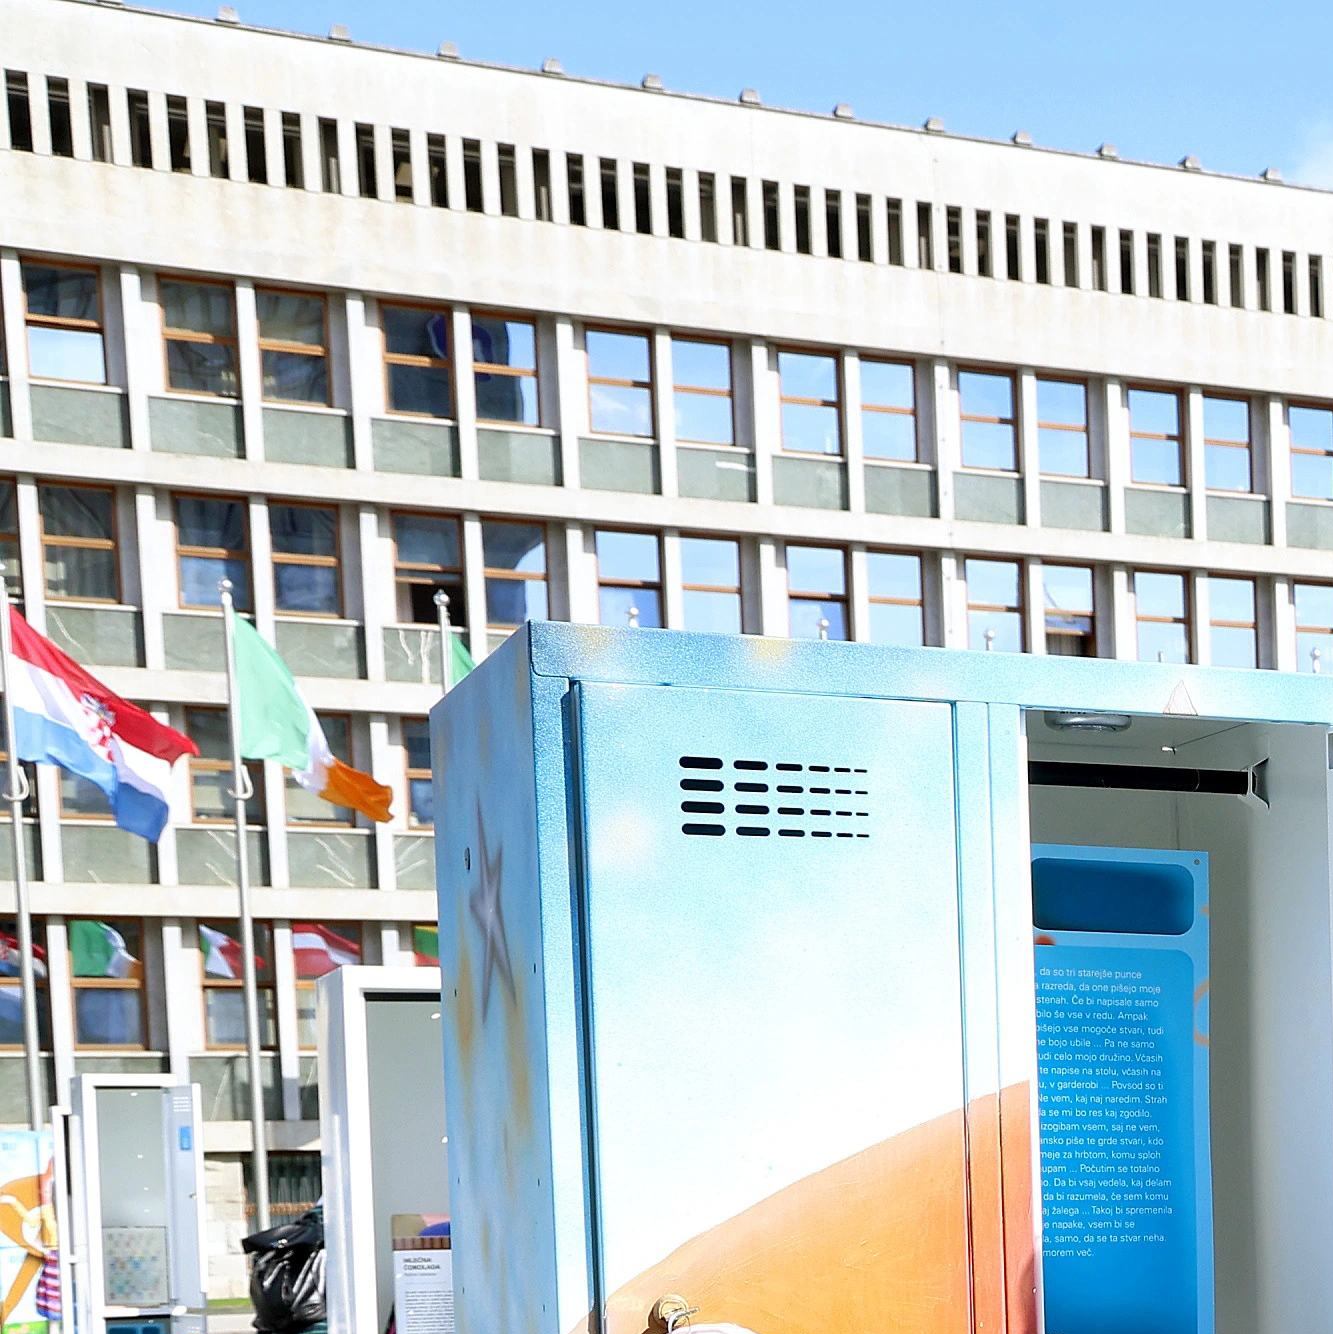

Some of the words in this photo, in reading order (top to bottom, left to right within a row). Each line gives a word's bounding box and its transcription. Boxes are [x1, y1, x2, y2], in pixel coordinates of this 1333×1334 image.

[1040, 967, 1050, 976] da
[1053, 969, 1064, 977] so
[1066, 969, 1075, 977] tri
[1078, 969, 1112, 980] starejše
[1115, 971, 1142, 980] punce
[1041, 982, 1076, 992] razreda,
[1079, 983, 1090, 991] da
[1111, 984, 1136, 994] pišejo
[1139, 985, 1160, 994] moje
[1036, 996, 1068, 1004] stenah.
[1072, 994, 1084, 1004] Če
[1086, 996, 1094, 1004] bi
[1096, 997, 1132, 1007] napisale
[1054, 1010, 1064, 1018] še
[1118, 1012, 1148, 1022] Ampak
[1081, 1025, 1117, 1035] mogoče
[1119, 1026, 1145, 1035] stvari,
[1048, 1038, 1068, 1048] bojo
[1070, 1039, 1091, 1047] ubile
[1104, 1039, 1115, 1047] Pa
[1054, 1052, 1072, 1061] celo
[1075, 1053, 1097, 1062] mojo
[1099, 1053, 1133, 1062] družino.
[1135, 1053, 1163, 1062] Včasih
[1095, 1067, 1118, 1076] stolu,
[1122, 1068, 1148, 1076] včasih
[1057, 1081, 1098, 1090] garderobi
[1111, 1081, 1142, 1089] Povsod
[1158, 1082, 1163, 1090] ti
[1075, 1094, 1087, 1104] kaj
[1090, 1095, 1102, 1105] naj
[1105, 1095, 1142, 1103] naredim.
[1144, 1095, 1167, 1104] Strah
[1075, 1108, 1087, 1116] bo
[1105, 1109, 1117, 1119] kaj
[1120, 1109, 1152, 1119] zgodilo.
[1040, 1122, 1079, 1132] izogibam
[1082, 1124, 1109, 1132] vsem,
[1111, 1123, 1124, 1132] saj
[1139, 1124, 1160, 1132] vem,
[1065, 1136, 1084, 1146] piše
[1098, 1136, 1118, 1146] grde
[1120, 1137, 1145, 1146] stvari,
[1148, 1137, 1164, 1145] kdo
[1075, 1151, 1109, 1160] hrbtom,
[1111, 1150, 1135, 1159] komu
[1138, 1151, 1160, 1160] sploh
[1080, 1164, 1115, 1173] Počutim
[1130, 1165, 1160, 1173] totalno
[1054, 1178, 1066, 1186] Da
[1068, 1178, 1076, 1187] bi
[1079, 1179, 1096, 1188] vsaj
[1098, 1179, 1128, 1188] vedela,
[1131, 1179, 1143, 1188] kaj
[1043, 1192, 1054, 1200] da
[1067, 1192, 1108, 1201] razumela,
[1052, 1206, 1079, 1216] žalega
[1091, 1206, 1113, 1216] Takoj
[1116, 1206, 1123, 1214] bi
[1125, 1206, 1173, 1216] spremenila
[1052, 1221, 1085, 1230] napake,
[1083, 1234, 1094, 1243] da
[1076, 1249, 1094, 1257] več.
